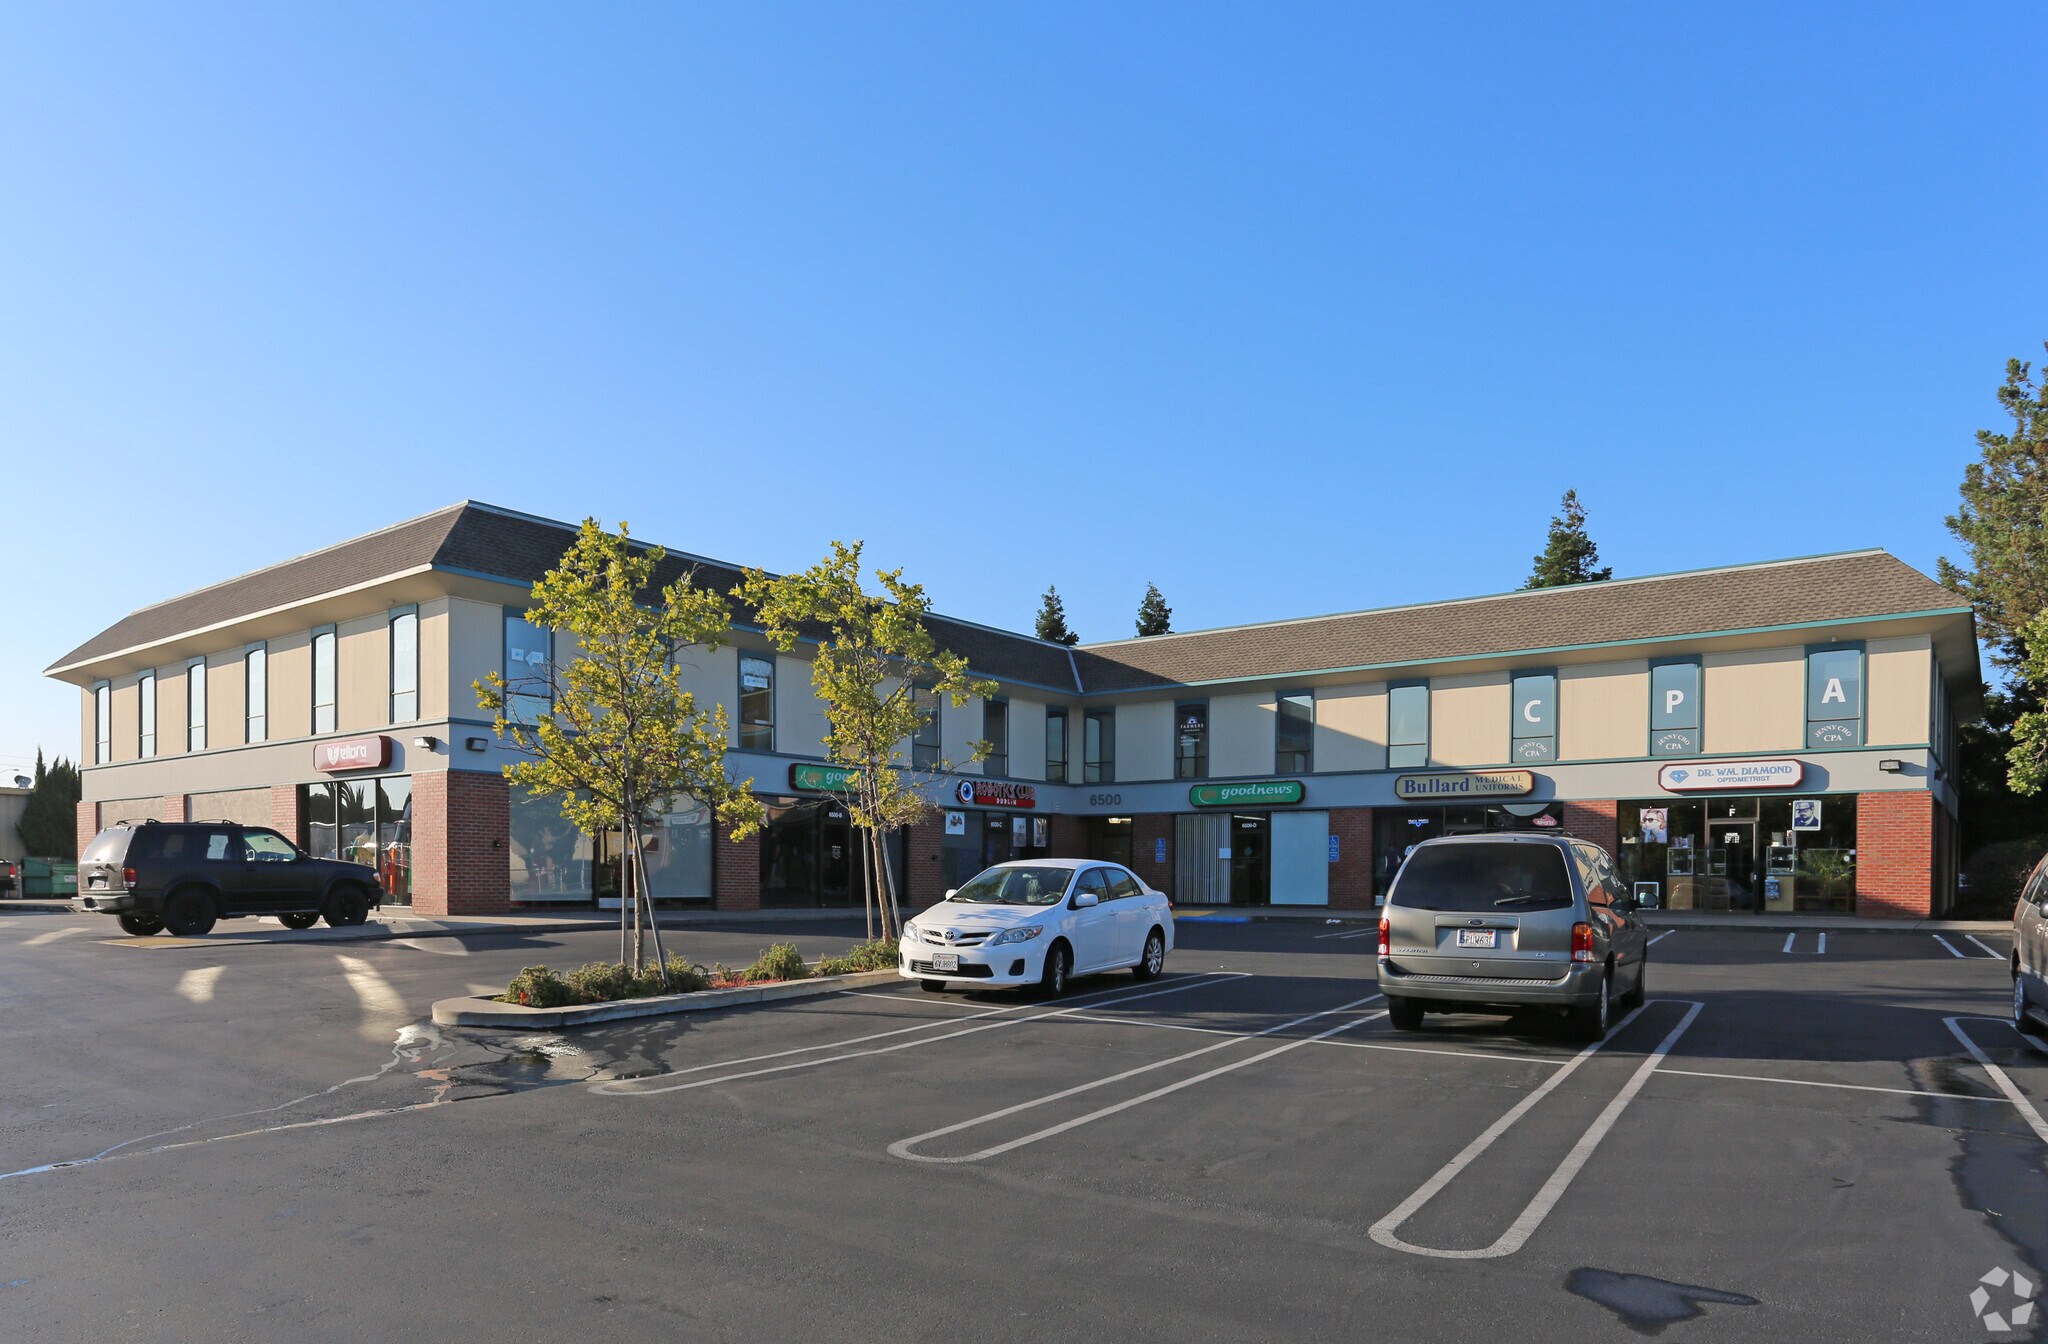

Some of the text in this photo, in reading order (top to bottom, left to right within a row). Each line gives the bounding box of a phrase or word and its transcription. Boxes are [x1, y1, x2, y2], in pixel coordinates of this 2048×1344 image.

[1821, 678, 1846, 703] A
[1666, 690, 1684, 713] P
[1524, 699, 1541, 722] C
[1814, 725, 1852, 738] JENNY CHO
[1658, 734, 1677, 746] JENNY
[1823, 734, 1842, 742] CPA
[1697, 765, 1793, 777] DR. WM. DIAMOND
[1475, 775, 1523, 784] MEDICAL
[1717, 775, 1770, 783] OPTOMETRIST
[1221, 784, 1293, 799] goodnews
[1404, 777, 1470, 794] Bullard
[1475, 783, 1524, 792] UNIFORMS
[1090, 793, 1122, 806] 6500
[1729, 808, 1736, 816] F
